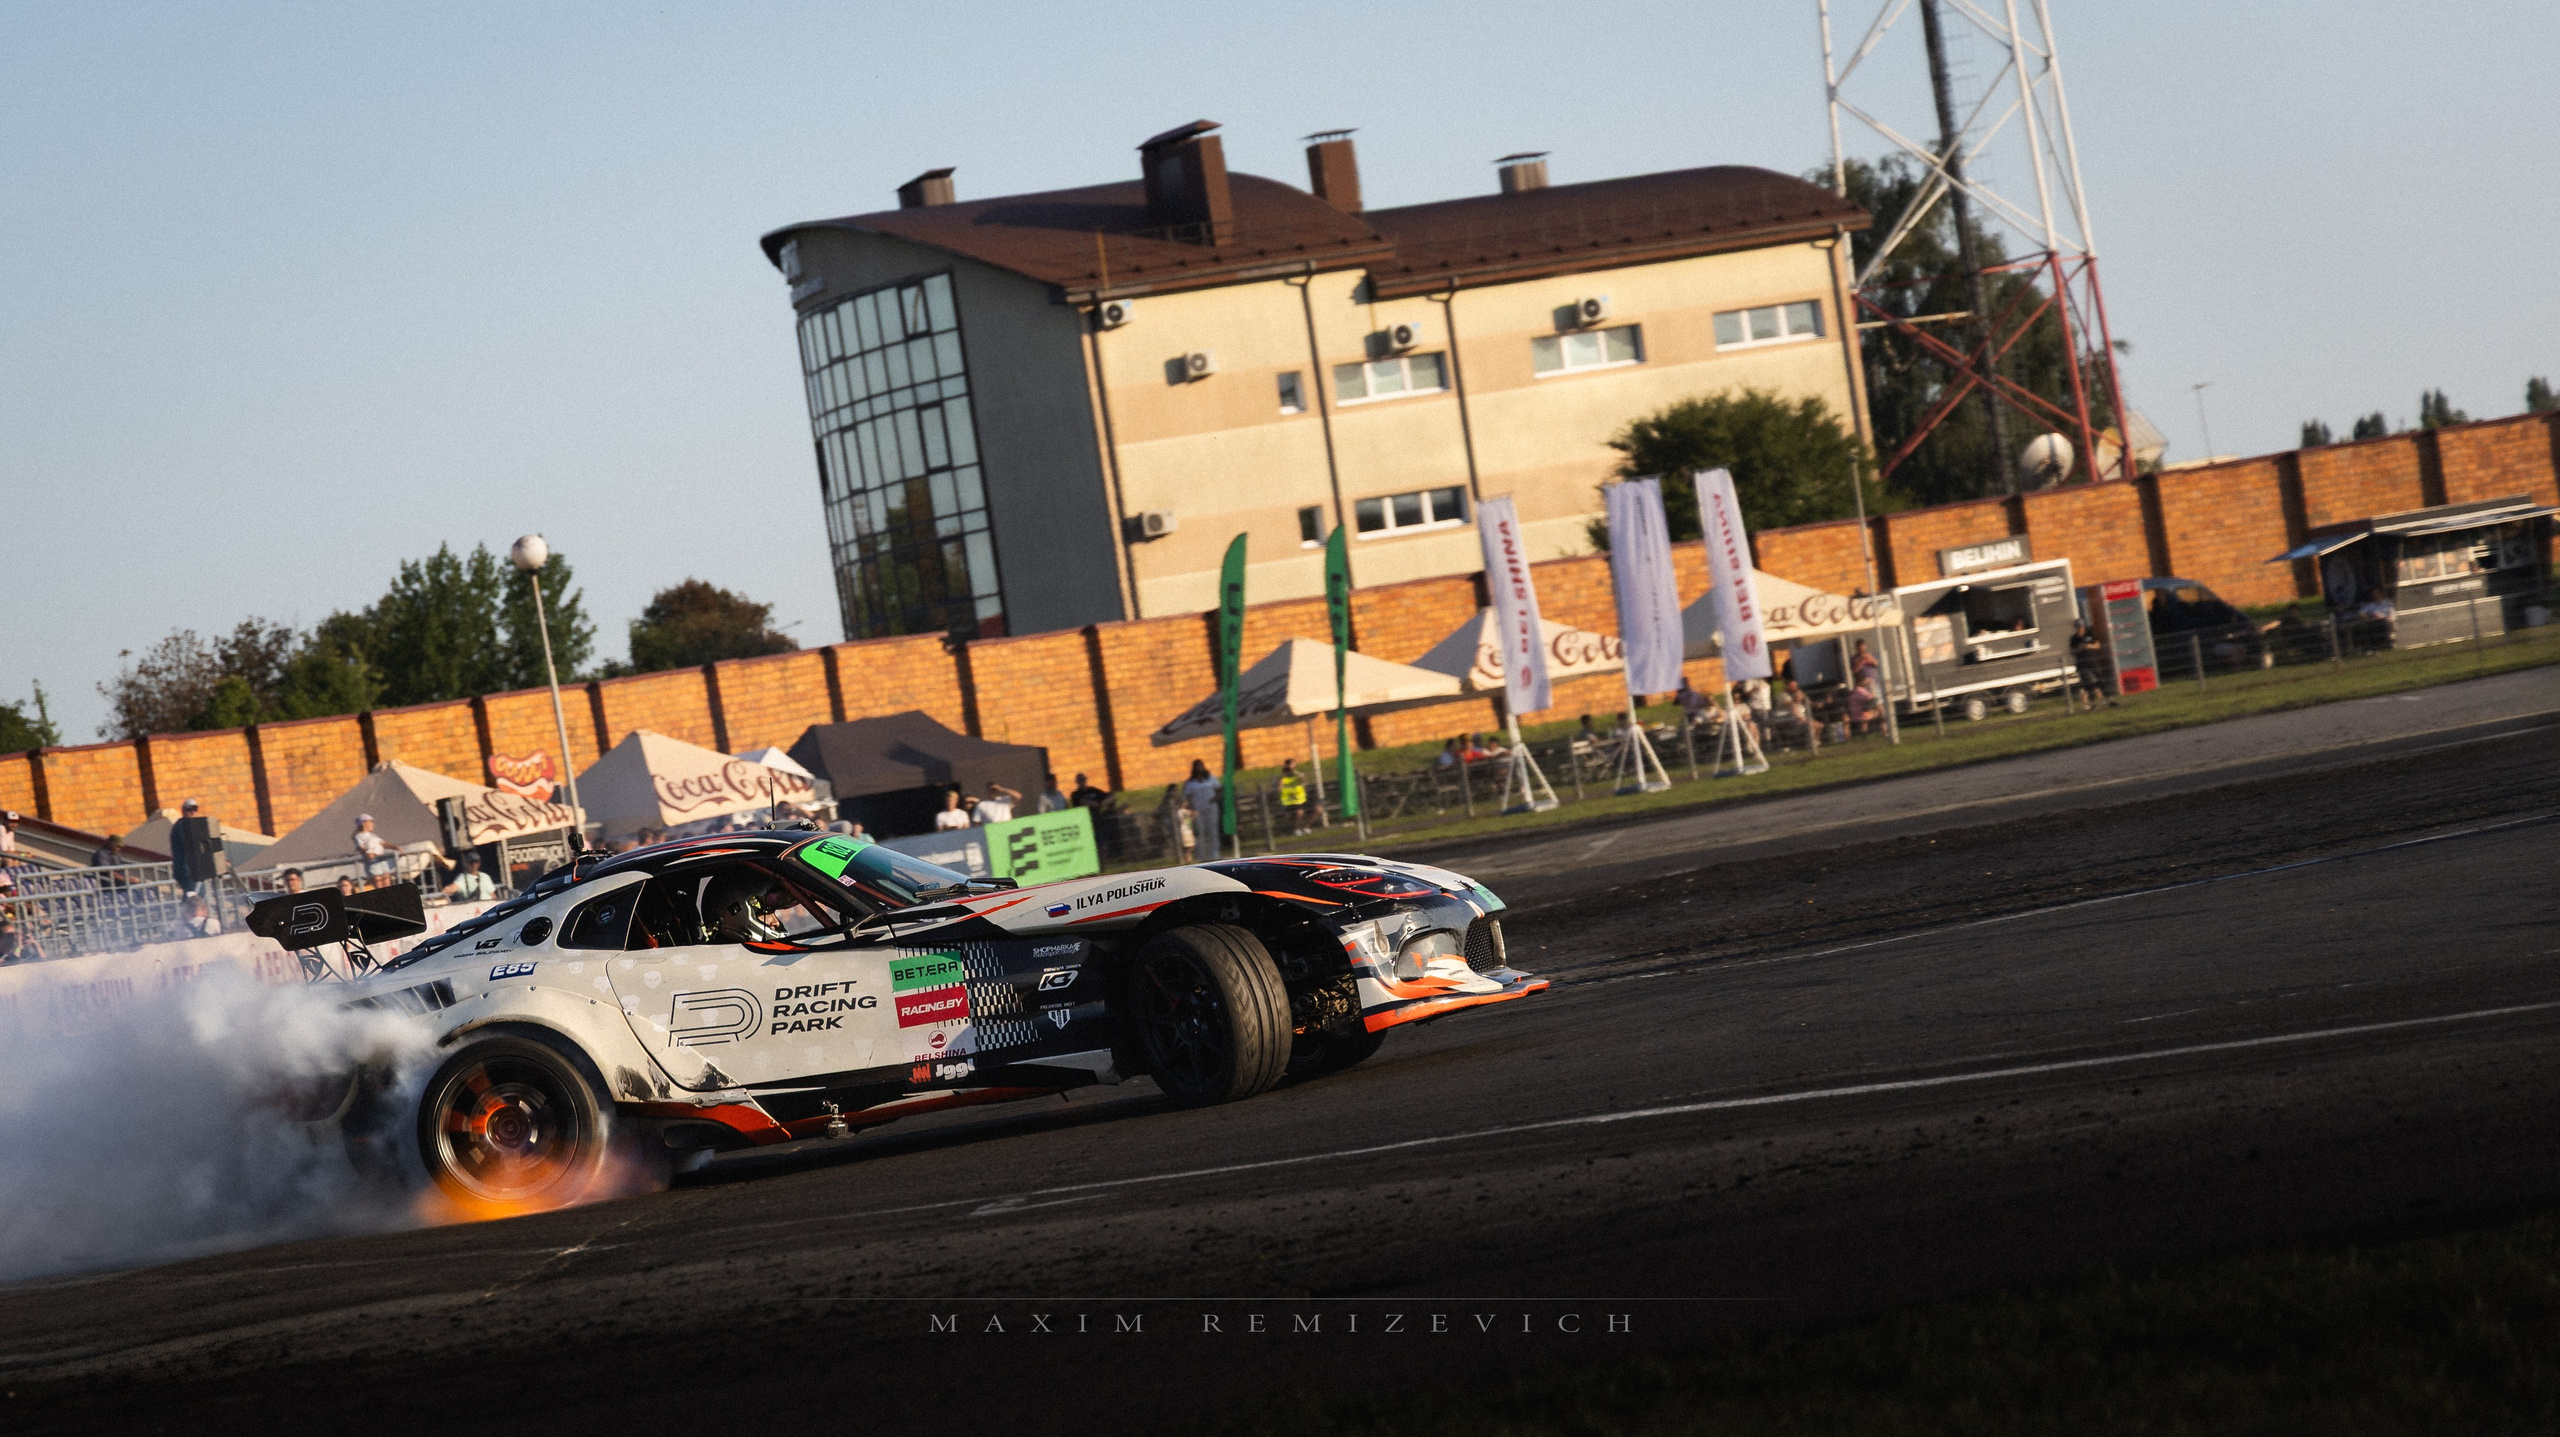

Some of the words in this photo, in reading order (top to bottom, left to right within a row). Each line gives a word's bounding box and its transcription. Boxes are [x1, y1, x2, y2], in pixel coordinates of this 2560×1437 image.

[1076, 893, 1104, 910] ILYA
[1106, 879, 1166, 902] POLISHUK
[1032, 943, 1075, 955] SHOPMARKA
[492, 962, 535, 977] E85
[774, 980, 858, 1001] DRIFT
[772, 996, 878, 1018] RACING
[901, 997, 963, 1017] RACING.BY
[770, 1015, 845, 1035] PARK
[914, 1047, 967, 1062] BELSHINA
